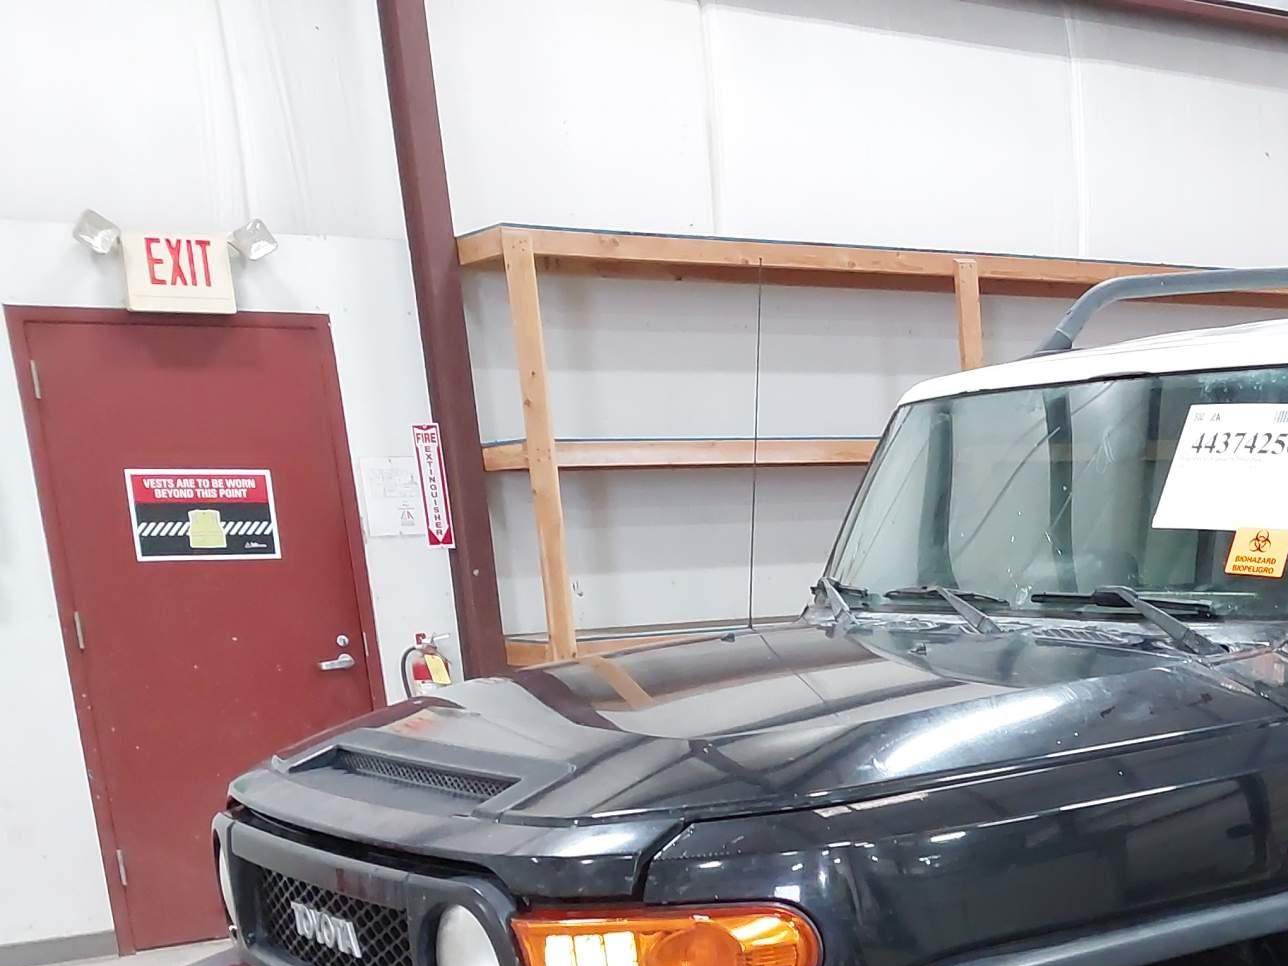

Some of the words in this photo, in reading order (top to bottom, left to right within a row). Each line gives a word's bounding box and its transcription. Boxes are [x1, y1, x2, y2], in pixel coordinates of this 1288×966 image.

[144, 236, 212, 287] EXIT
[415, 432, 437, 444] FIRE
[143, 478, 175, 489] VESTS
[176, 478, 195, 488] ARE
[197, 478, 209, 488] TO
[211, 478, 224, 488] BE
[225, 478, 256, 489] WORN
[154, 488, 194, 499] BEYOND
[196, 488, 217, 498] THIS
[219, 488, 248, 498] POINT
[424, 445, 443, 536] EXTINGUISHER
[1234, 555, 1277, 565] BIOHAZARD
[1231, 565, 1275, 575] BIOPELIGRO
[290, 901, 362, 959] TOYOTA
